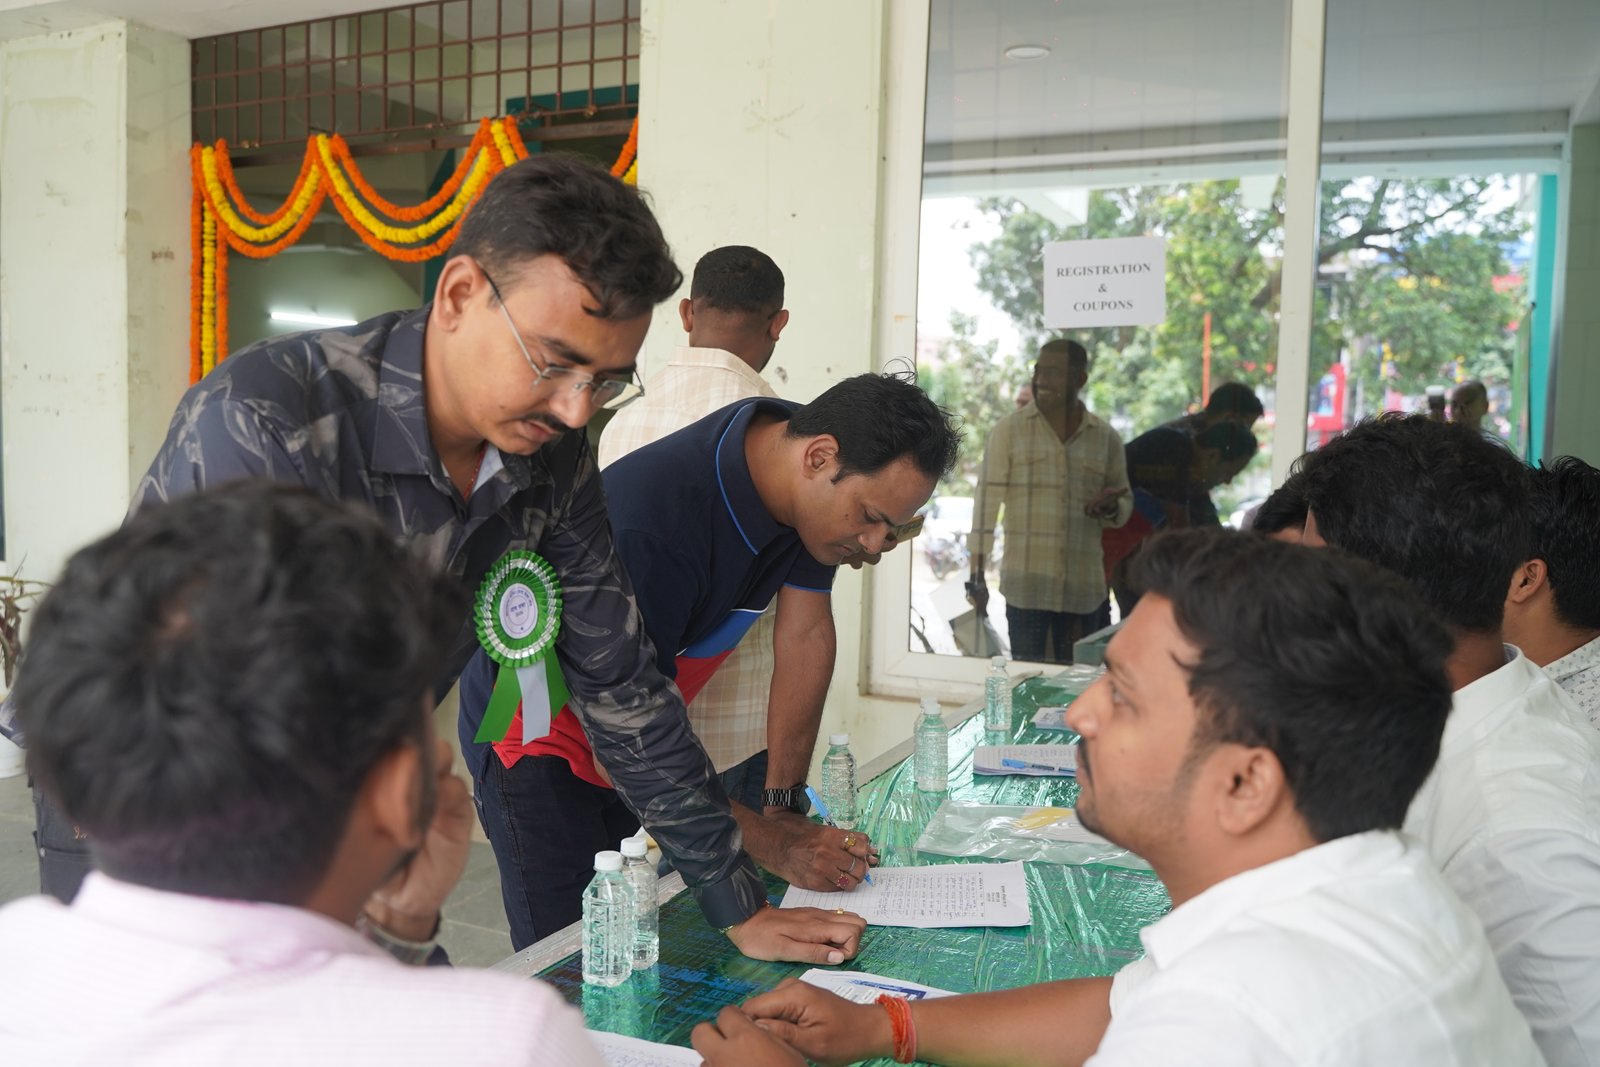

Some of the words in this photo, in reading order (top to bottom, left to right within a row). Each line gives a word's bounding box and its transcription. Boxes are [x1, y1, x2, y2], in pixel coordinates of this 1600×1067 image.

[1056, 262, 1152, 278] REGISTRATION
[1097, 283, 1108, 293] &
[1073, 299, 1134, 312] COUPONS
